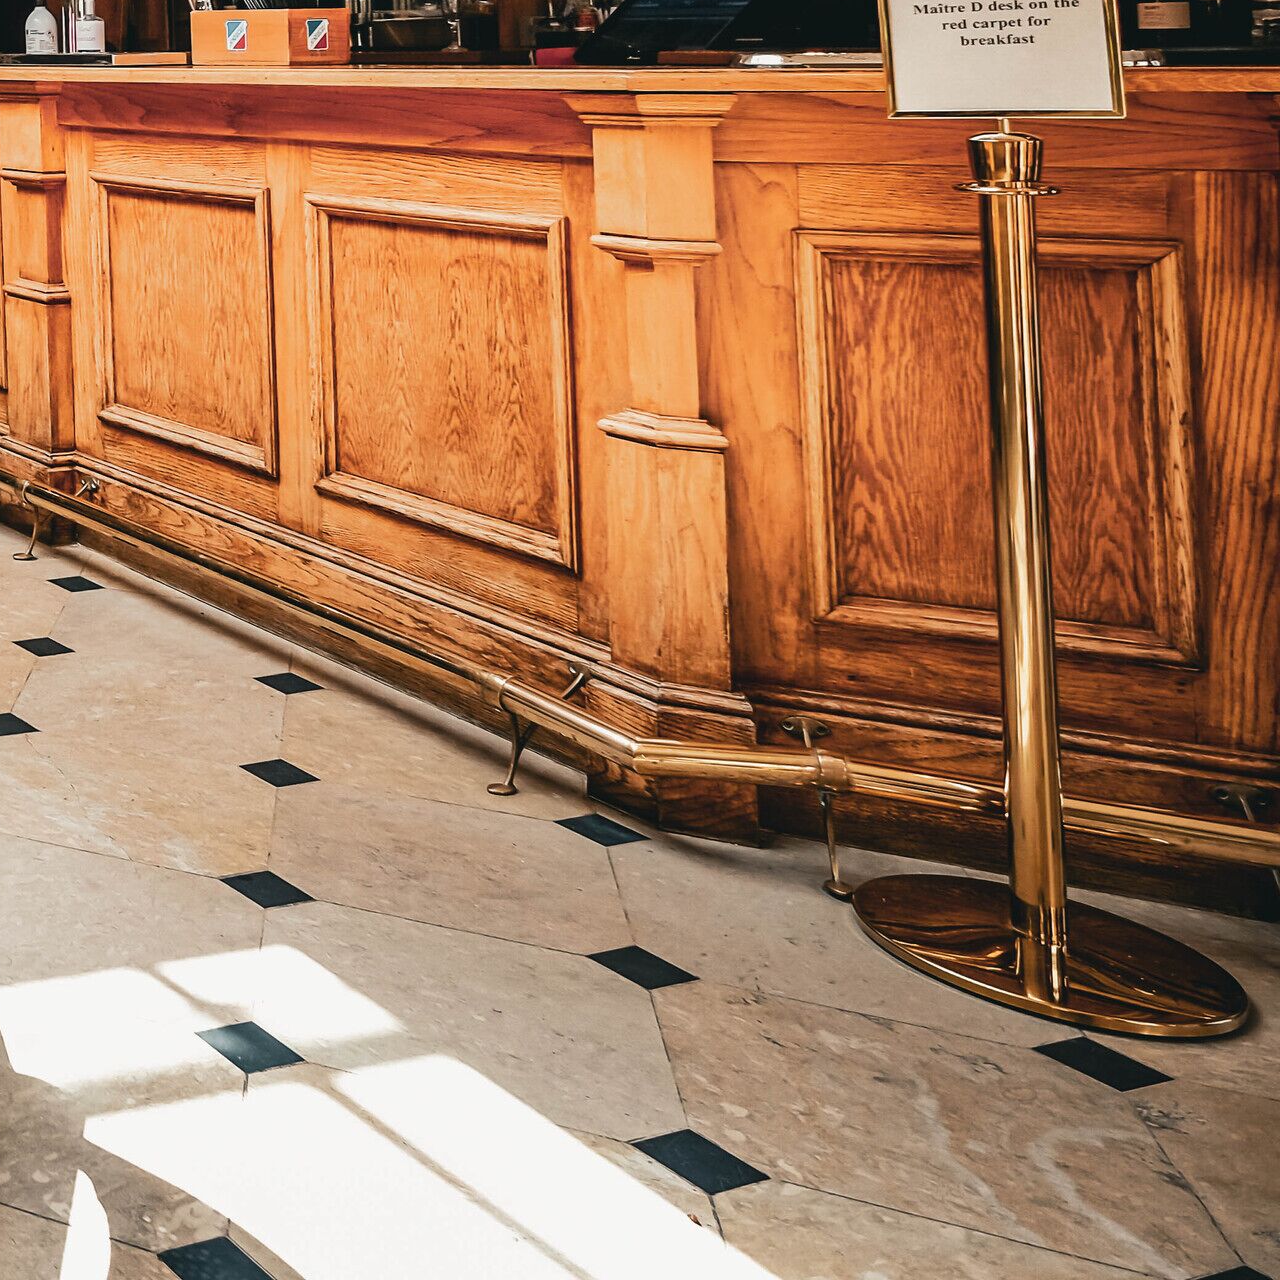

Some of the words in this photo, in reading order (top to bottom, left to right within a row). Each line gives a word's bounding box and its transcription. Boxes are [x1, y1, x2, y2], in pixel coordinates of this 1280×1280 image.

[913, 3, 966, 15] Maître
[971, 1, 983, 12] D
[988, 0, 1024, 11] desk
[1028, 0, 1048, 10] on
[942, 19, 967, 31] red
[972, 18, 1022, 31] carpet
[1027, 16, 1051, 27] for
[960, 33, 1035, 47] breakfast
